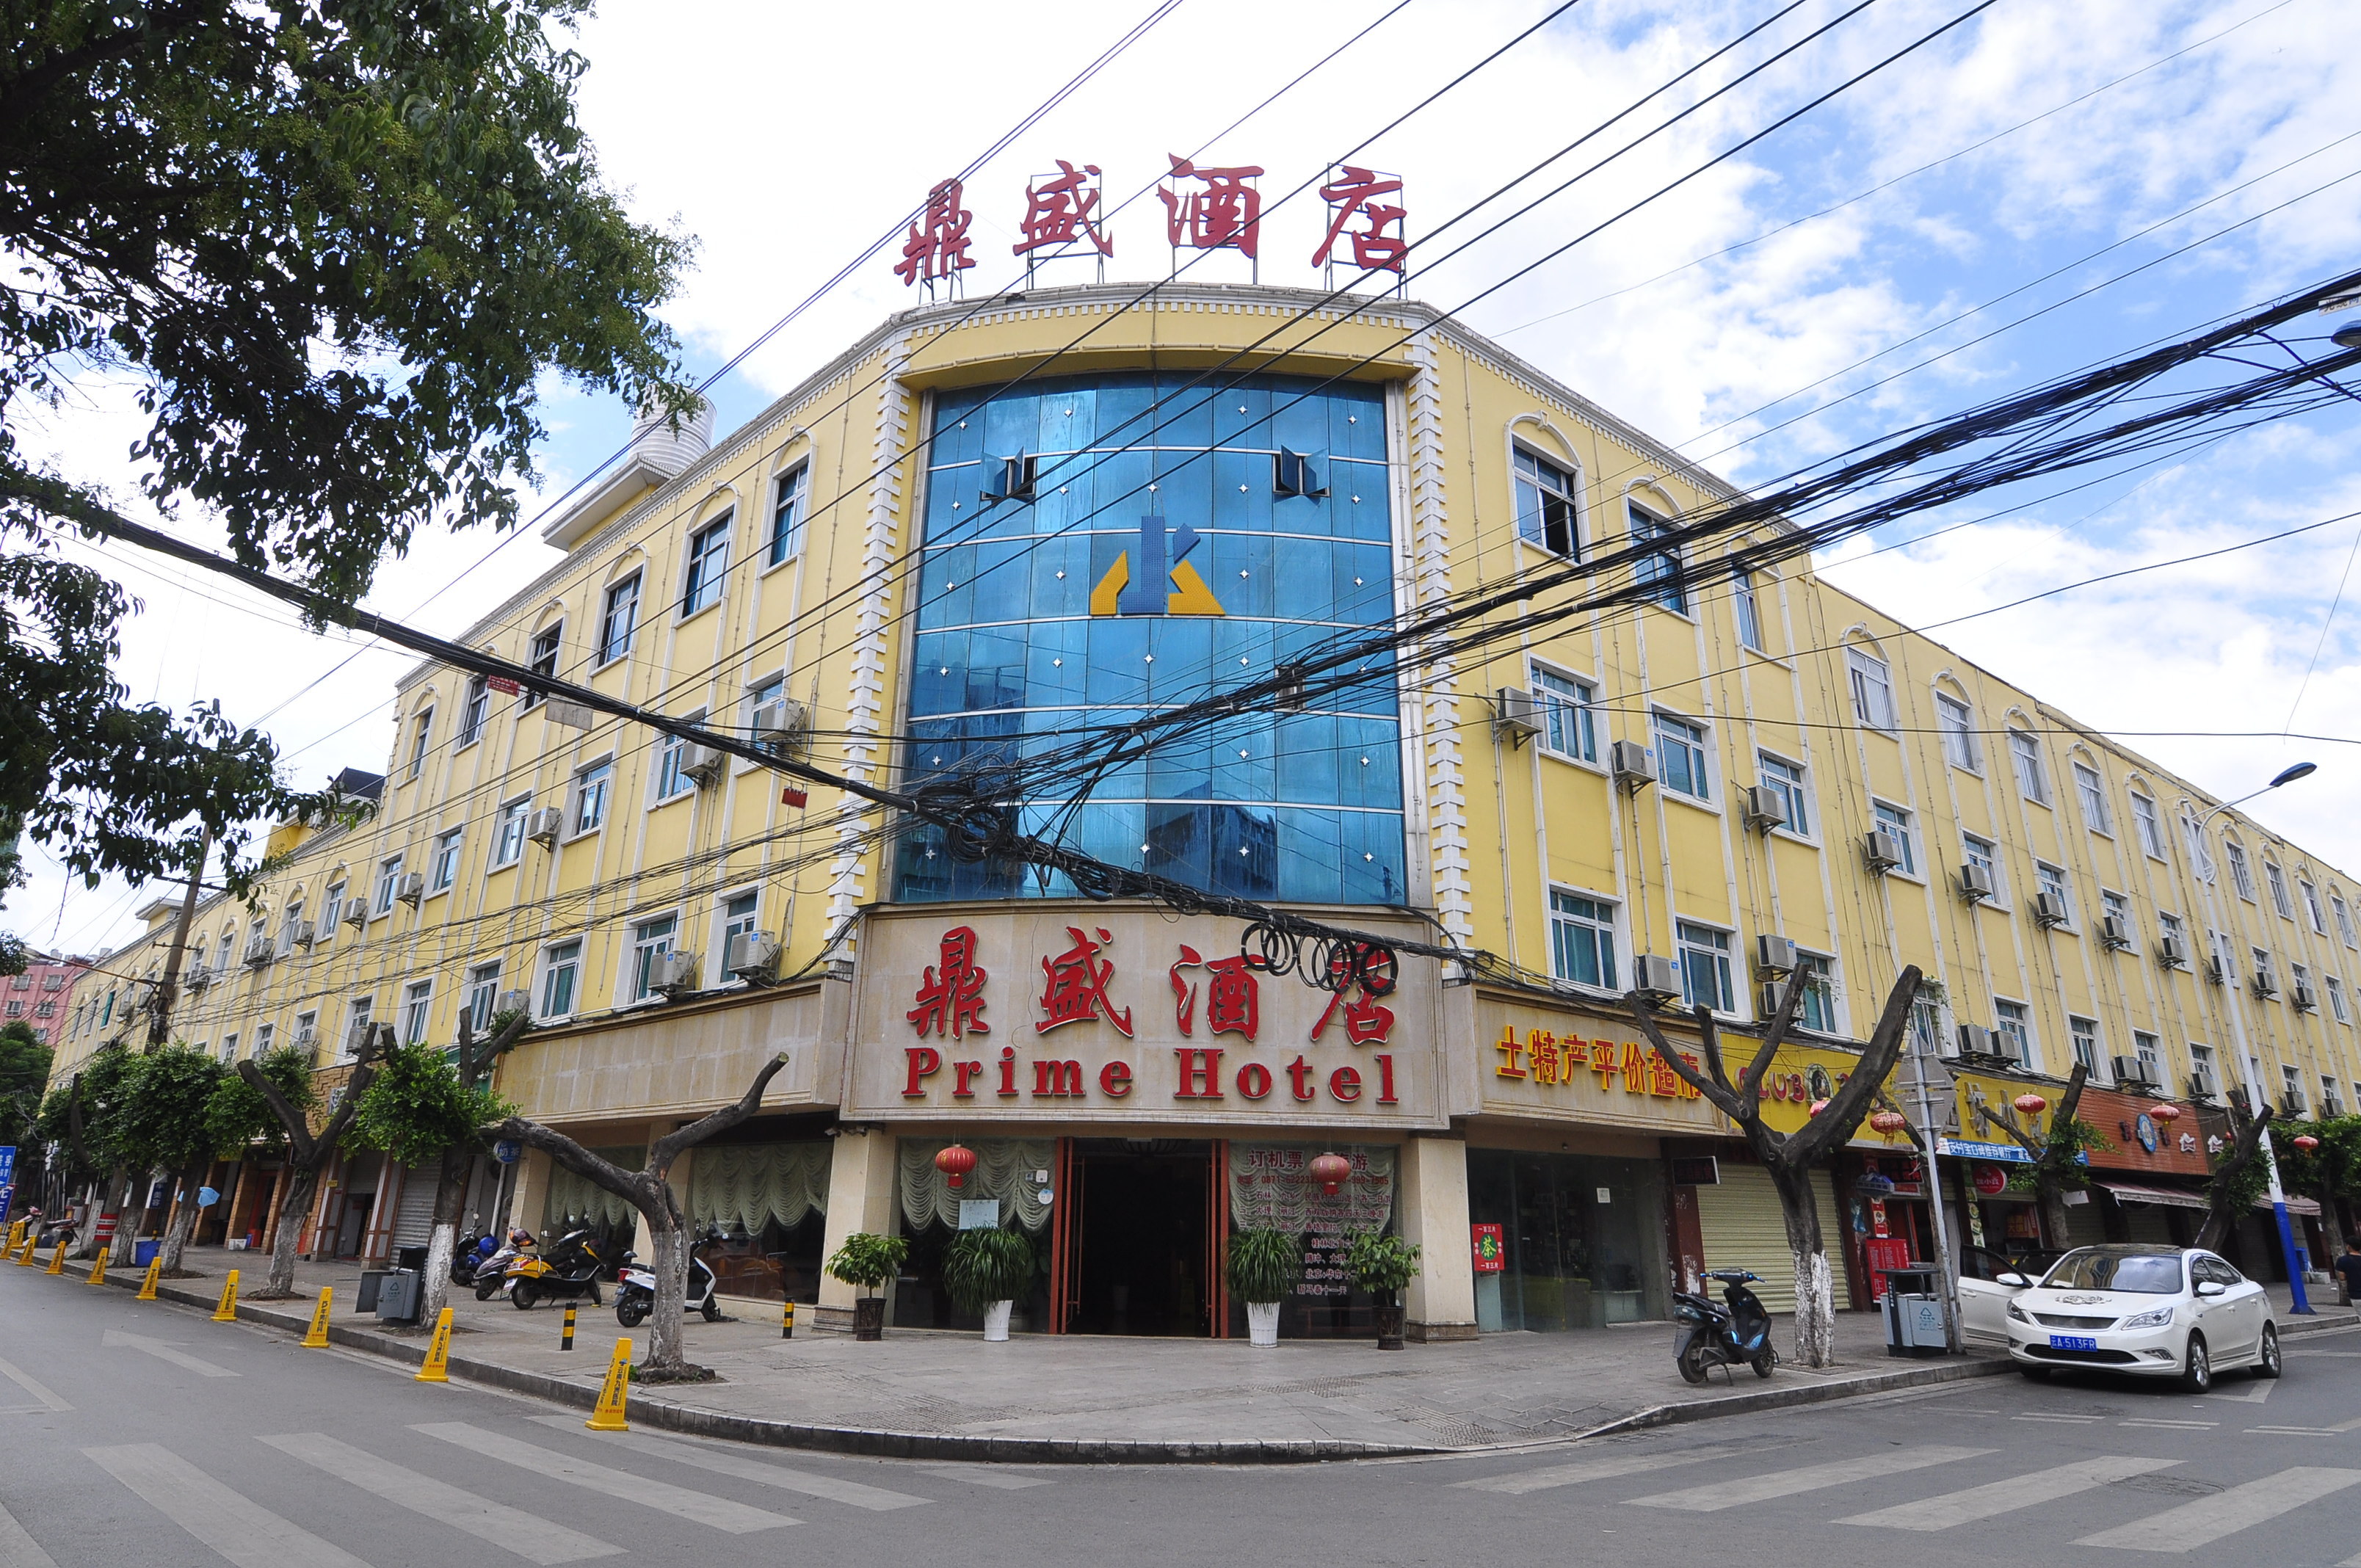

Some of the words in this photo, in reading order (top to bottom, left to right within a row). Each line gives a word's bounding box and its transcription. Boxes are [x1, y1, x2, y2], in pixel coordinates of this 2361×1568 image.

[894, 153, 1409, 286] 鼎盛酒店
[907, 926, 1397, 1046] 鼎盛酒店
[901, 1045, 1134, 1098] Prime
[1174, 1048, 1400, 1105] Hotel
[1496, 1025, 1702, 1099] 土特产平价超市
[1249, 1150, 1305, 1169] 订机票
[1481, 1235, 1496, 1257] 茶
